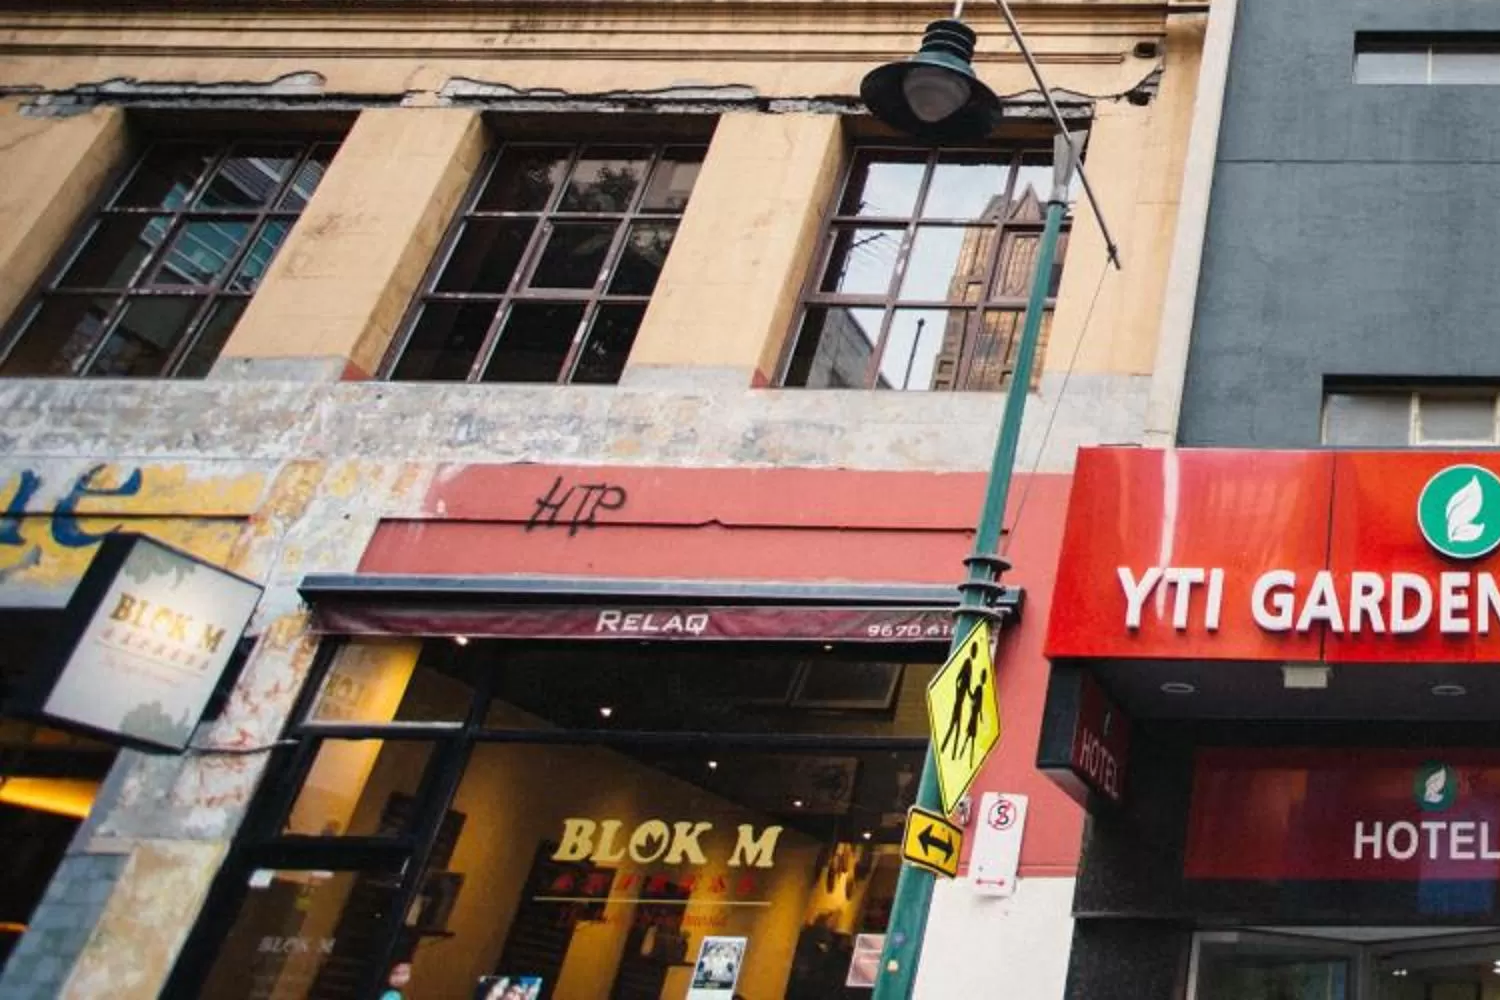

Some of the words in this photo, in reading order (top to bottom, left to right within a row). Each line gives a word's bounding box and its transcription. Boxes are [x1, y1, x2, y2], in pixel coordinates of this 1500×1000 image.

[596, 610, 708, 635] RELAQ
[1117, 567, 1224, 631] YTI
[1080, 727, 1119, 800] HOTEL
[552, 819, 713, 864] BLOK
[727, 823, 784, 868] M
